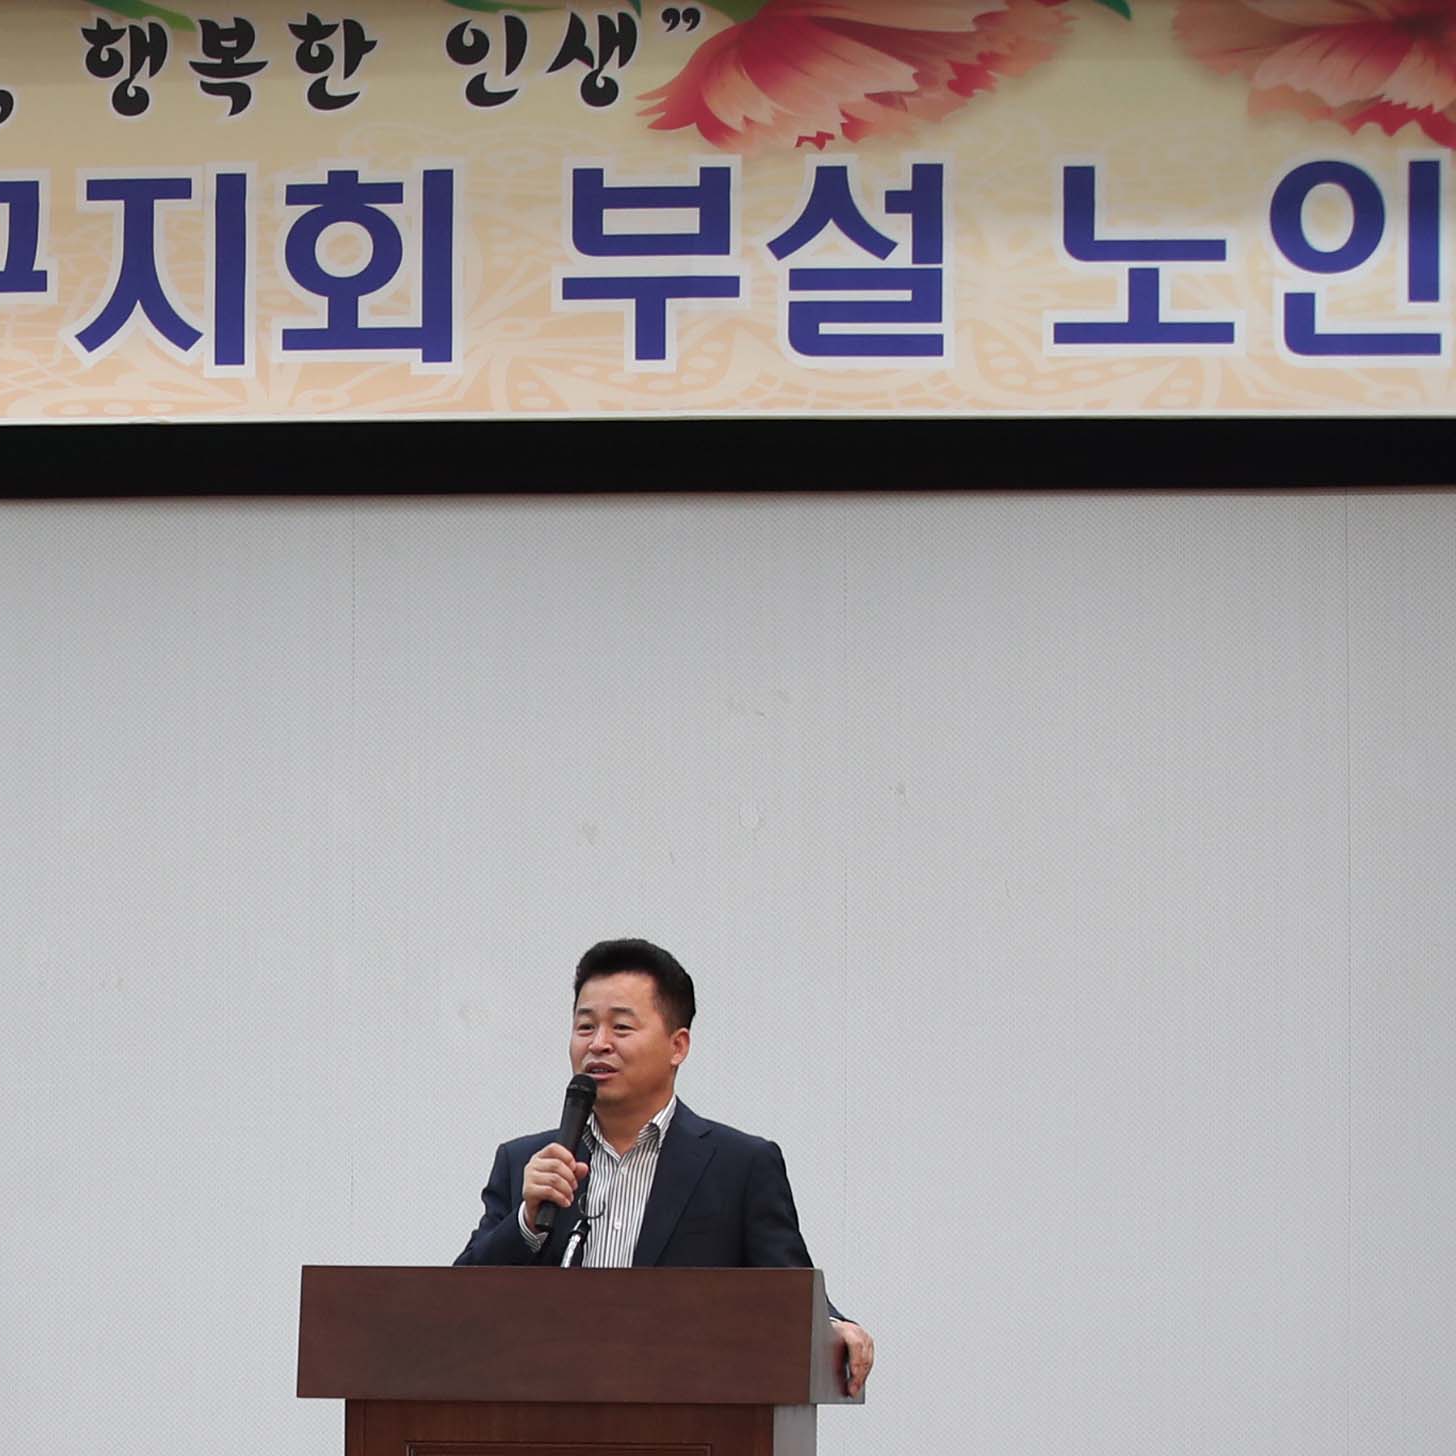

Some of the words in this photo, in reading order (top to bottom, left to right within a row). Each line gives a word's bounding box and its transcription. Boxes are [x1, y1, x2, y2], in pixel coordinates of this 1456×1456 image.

[81, 16, 378, 117] 행복한
[446, 8, 702, 108] 인생”
[564, 164, 944, 361] 부설
[1054, 160, 1442, 356] 노인
